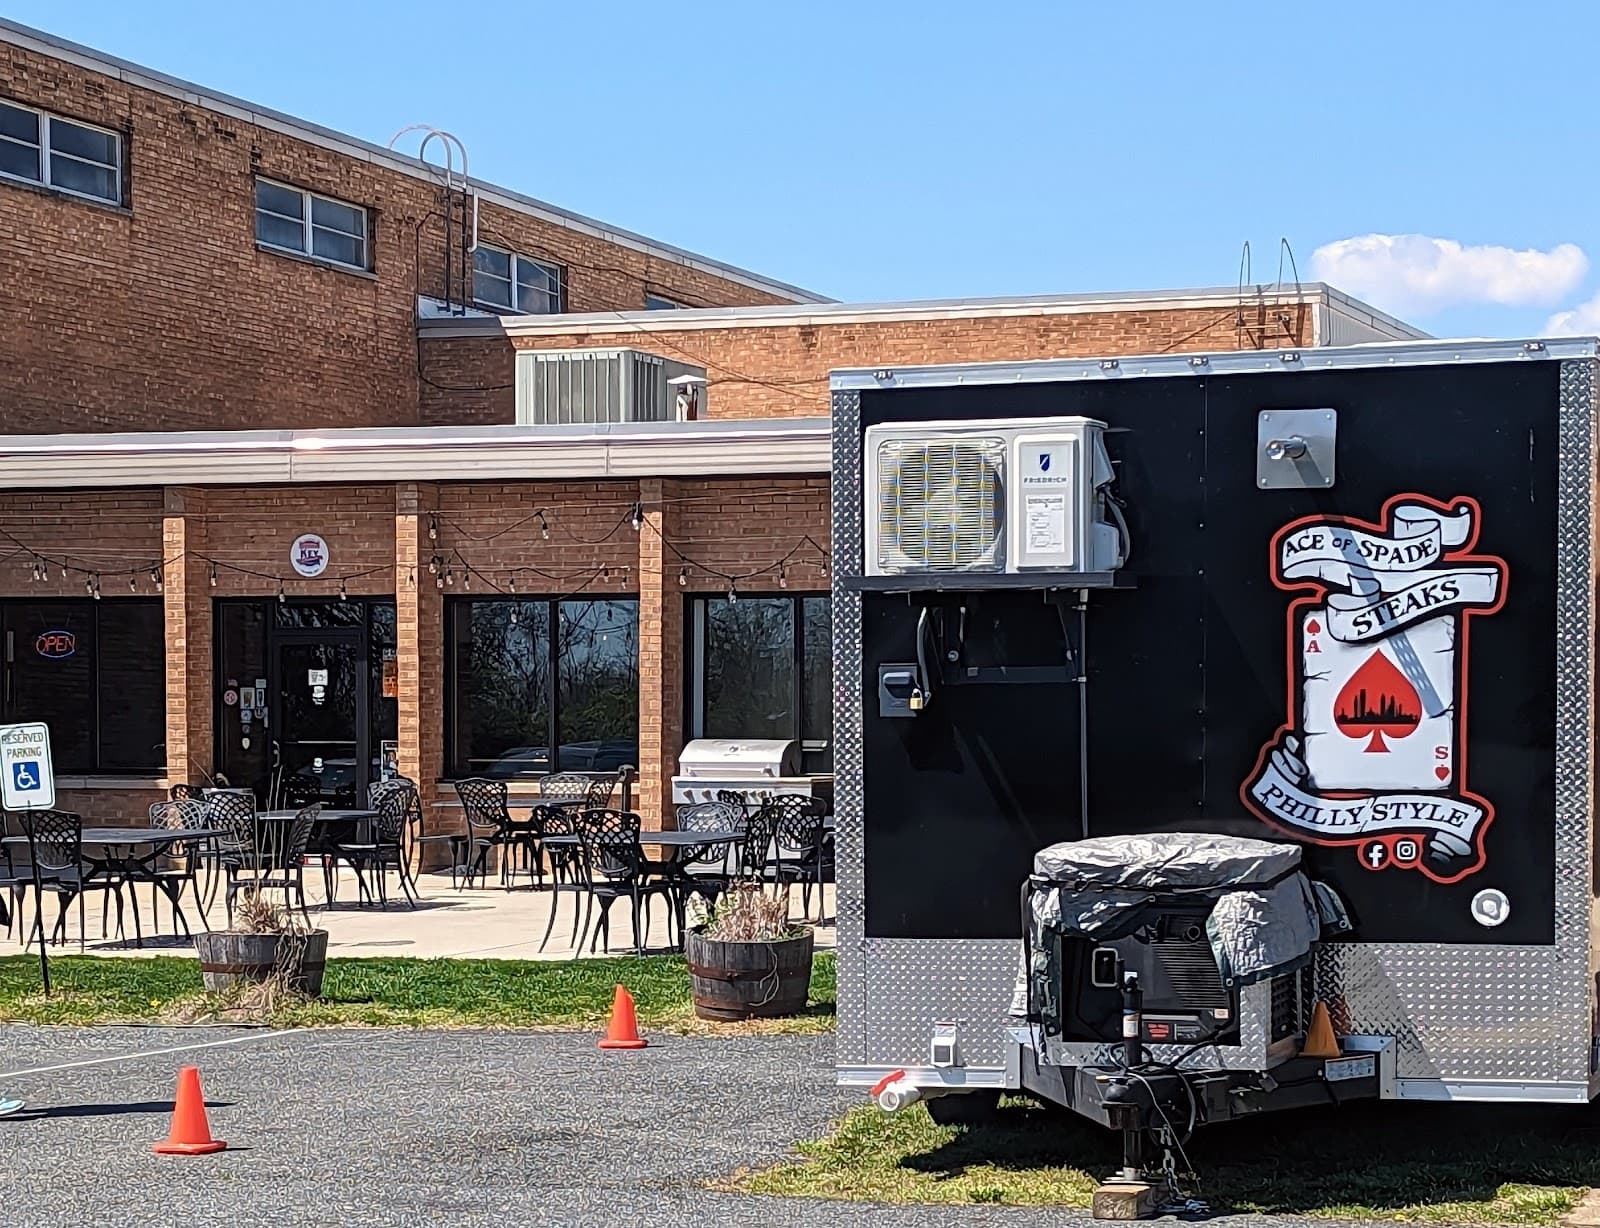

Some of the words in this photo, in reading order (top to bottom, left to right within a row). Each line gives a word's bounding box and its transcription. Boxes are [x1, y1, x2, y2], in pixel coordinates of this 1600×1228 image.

[1285, 534, 1325, 558] ACE
[1356, 538, 1438, 565] SPADE
[1352, 579, 1461, 637] STEAKS
[36, 635, 76, 653] OPEN
[1306, 641, 1322, 653] A
[1, 732, 44, 744] RESERVED
[7, 746, 42, 759] PARKING
[1434, 746, 1449, 760] S
[1260, 782, 1366, 827] PHILLY
[1370, 802, 1470, 828] STYLE
